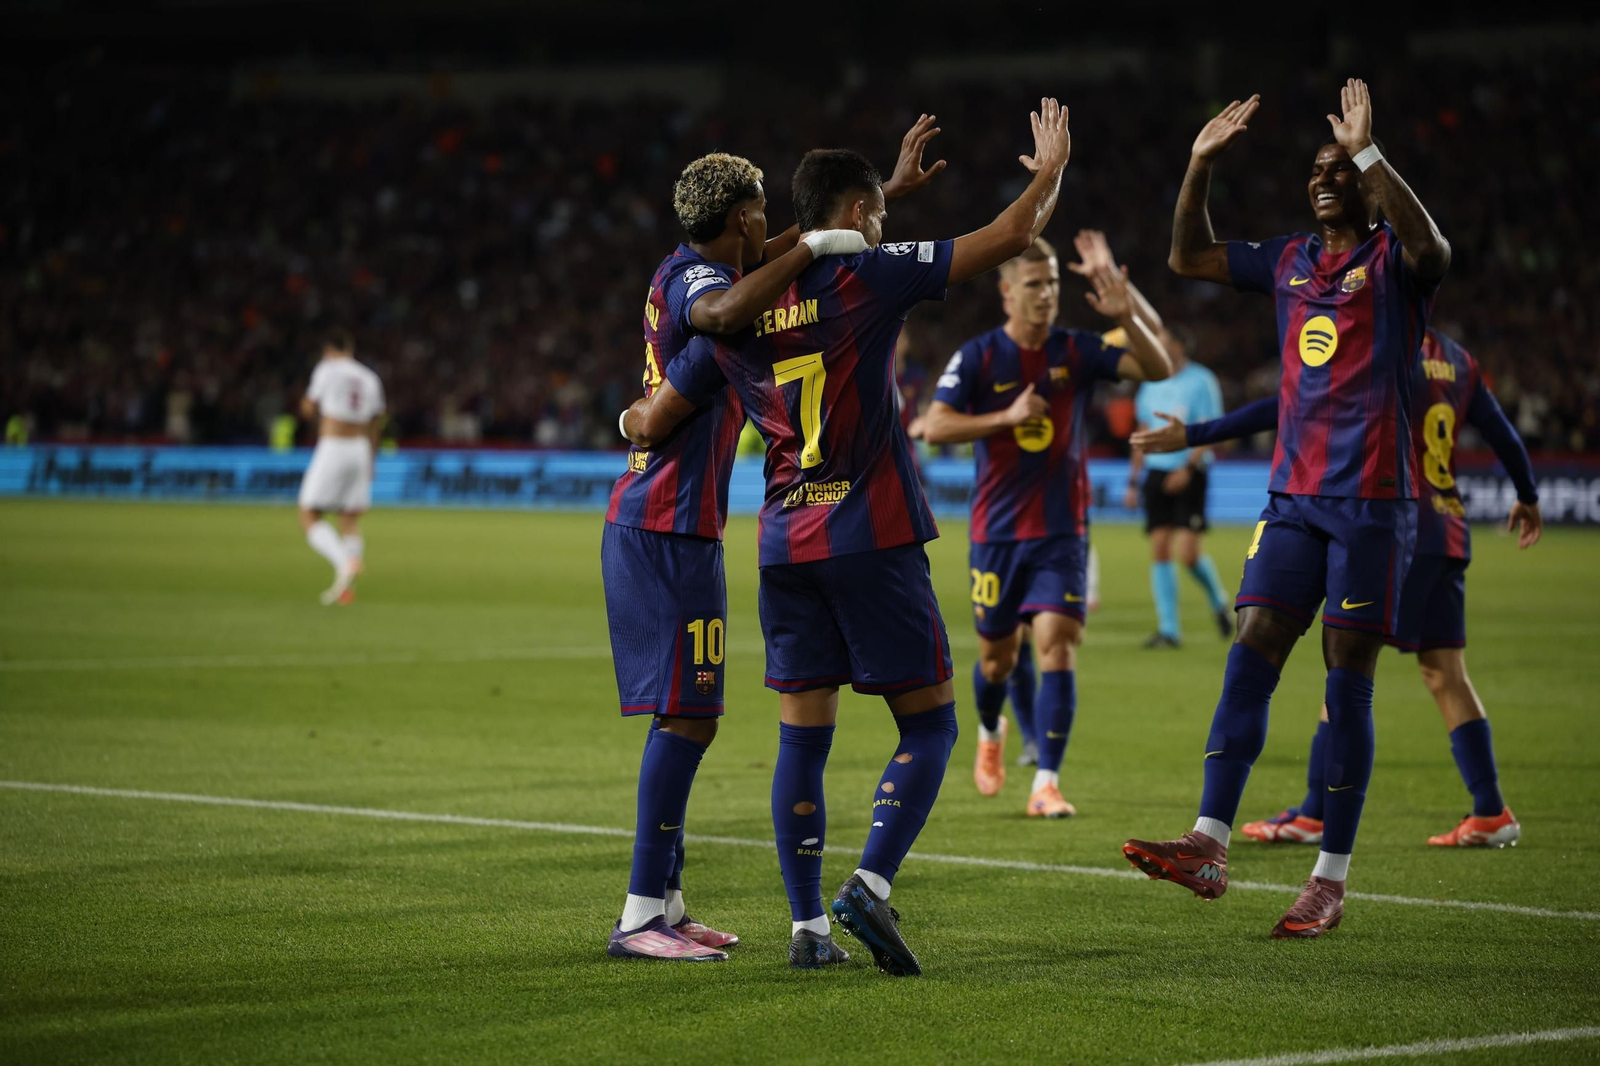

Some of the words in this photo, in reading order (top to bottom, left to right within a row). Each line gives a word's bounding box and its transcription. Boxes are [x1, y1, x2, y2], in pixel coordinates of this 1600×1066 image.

[754, 299, 819, 337] FERRAN
[771, 351, 826, 469] 7
[1423, 403, 1456, 490] 8
[805, 481, 850, 492] UNHCR
[971, 568, 1000, 607] 20
[687, 618, 723, 665] 10
